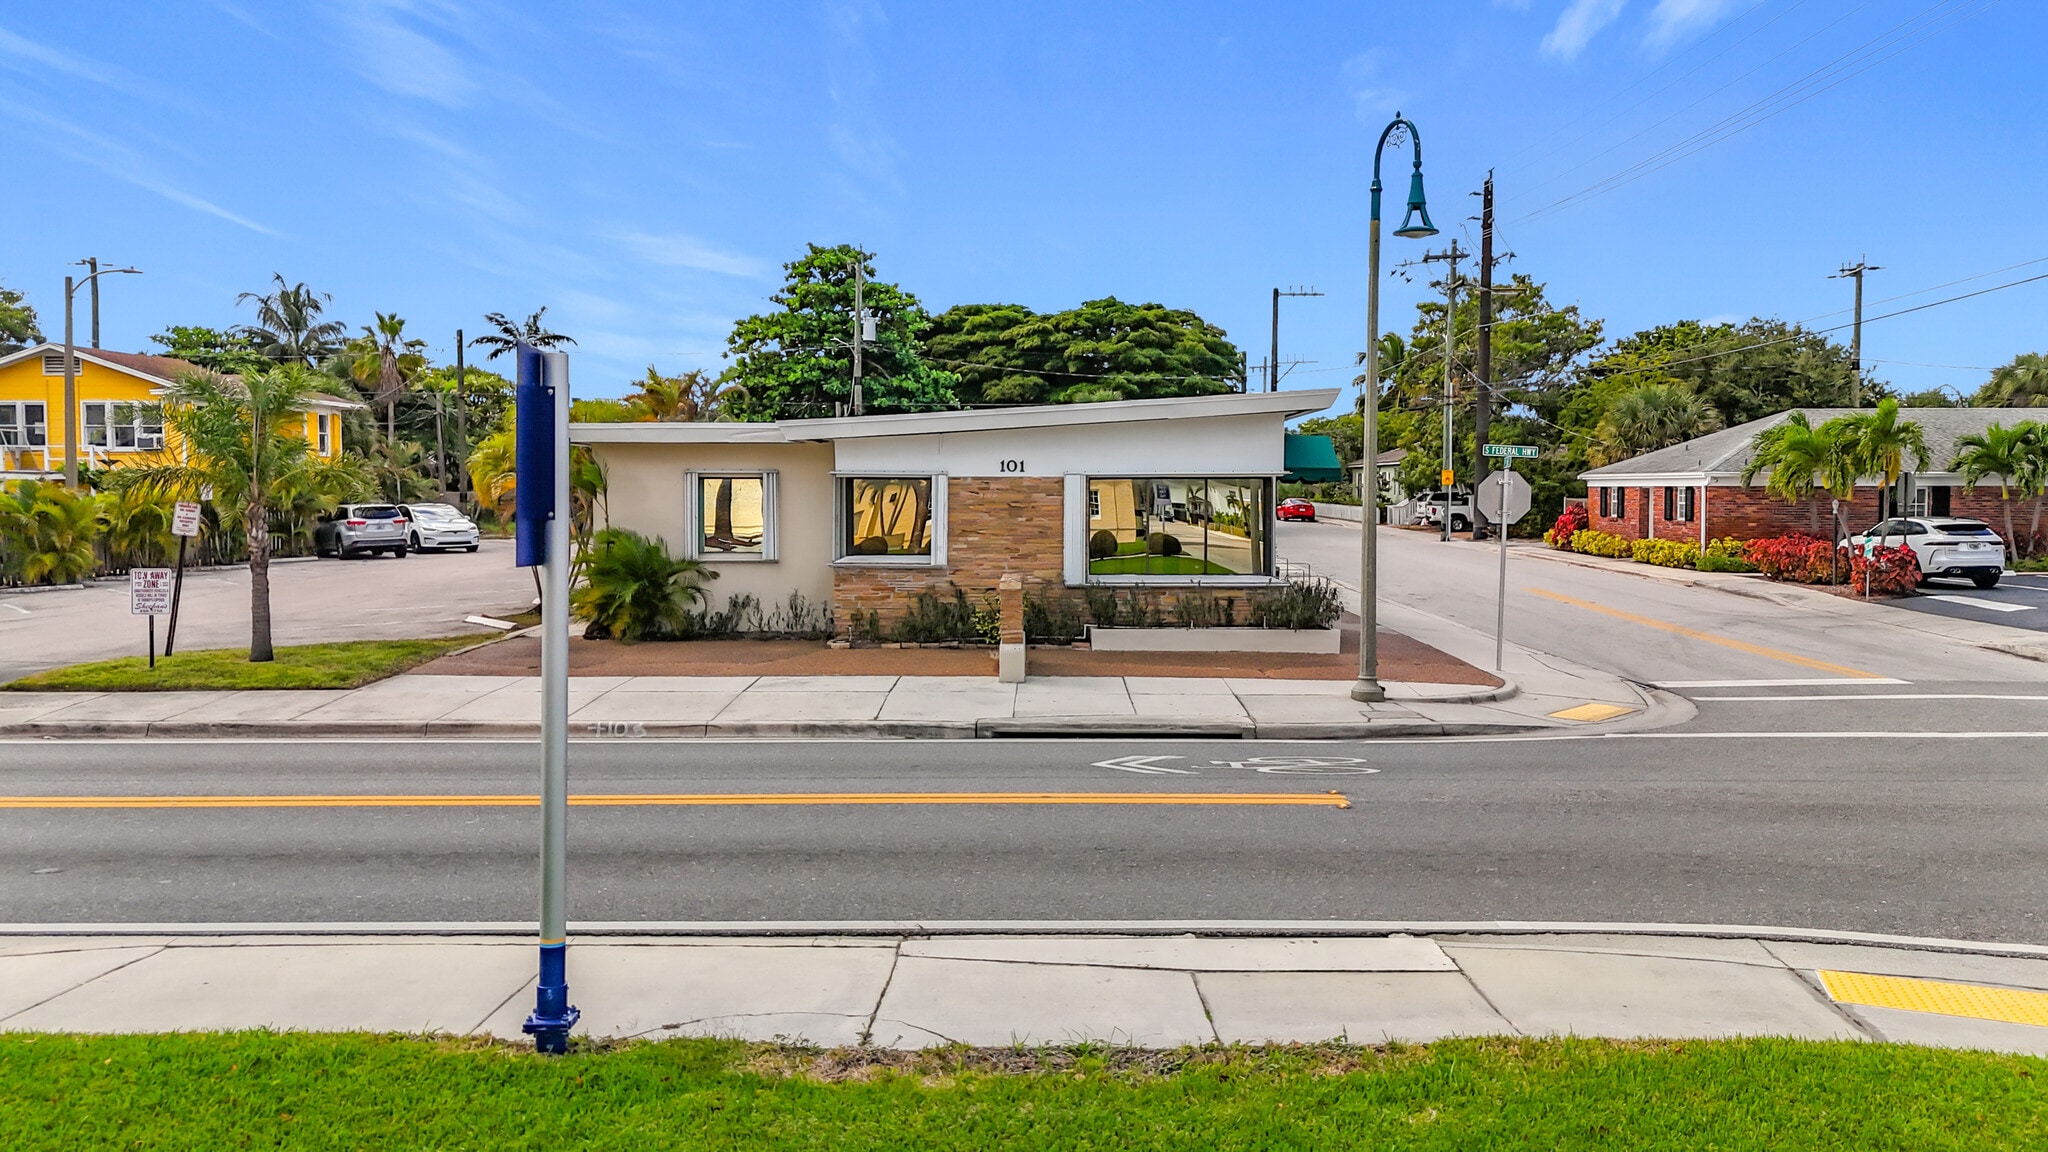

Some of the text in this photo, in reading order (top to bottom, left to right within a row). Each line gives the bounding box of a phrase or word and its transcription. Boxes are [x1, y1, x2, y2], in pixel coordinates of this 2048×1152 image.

[1485, 446, 1537, 457] S FEDERAL HWY
[1000, 459, 1025, 473] 101
[134, 571, 169, 580] TOW AWAY
[143, 580, 160, 589] ZONE
